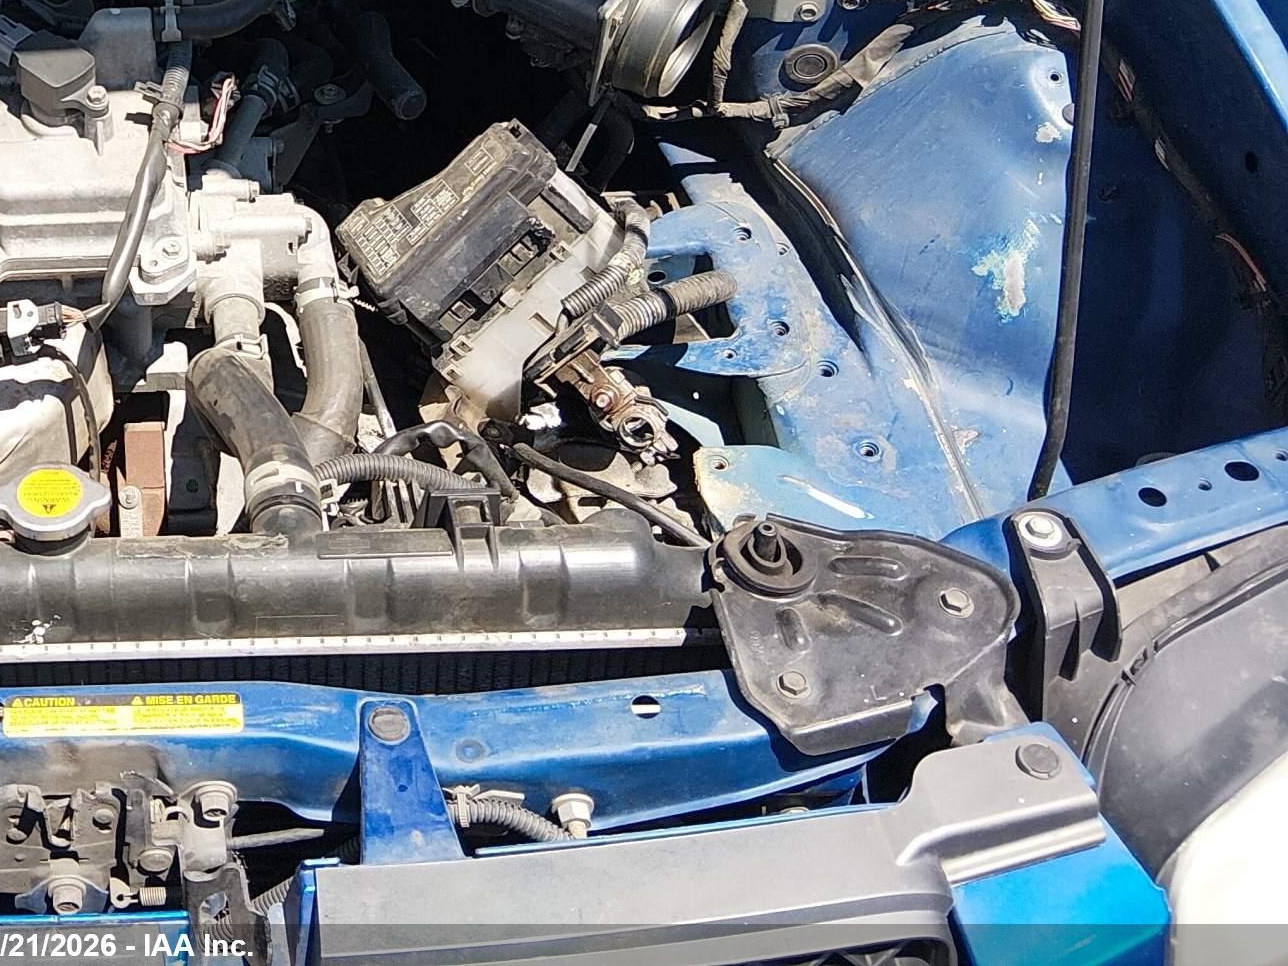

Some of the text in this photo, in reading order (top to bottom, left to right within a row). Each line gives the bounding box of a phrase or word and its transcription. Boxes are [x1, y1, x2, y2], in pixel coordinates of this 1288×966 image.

[23, 696, 76, 707] CAUTION
[145, 694, 237, 706] MISE EN GARDE
